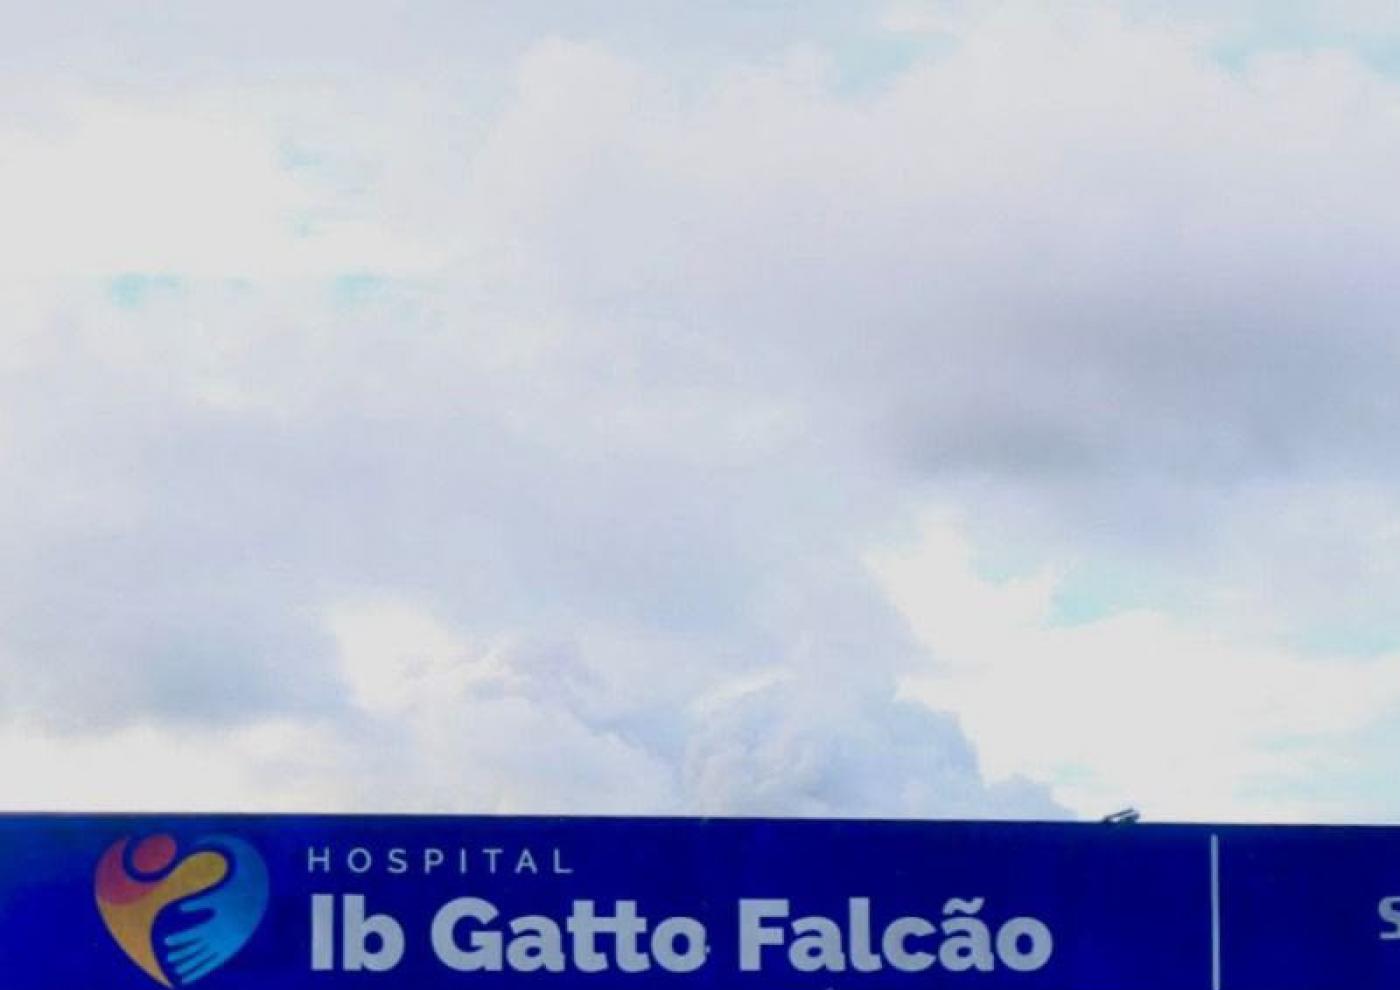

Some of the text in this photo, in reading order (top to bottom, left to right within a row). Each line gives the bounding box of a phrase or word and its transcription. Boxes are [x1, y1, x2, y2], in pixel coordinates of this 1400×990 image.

[308, 847, 574, 874] HOSPITAL
[311, 893, 1053, 973] Ib Gatto Falcão
